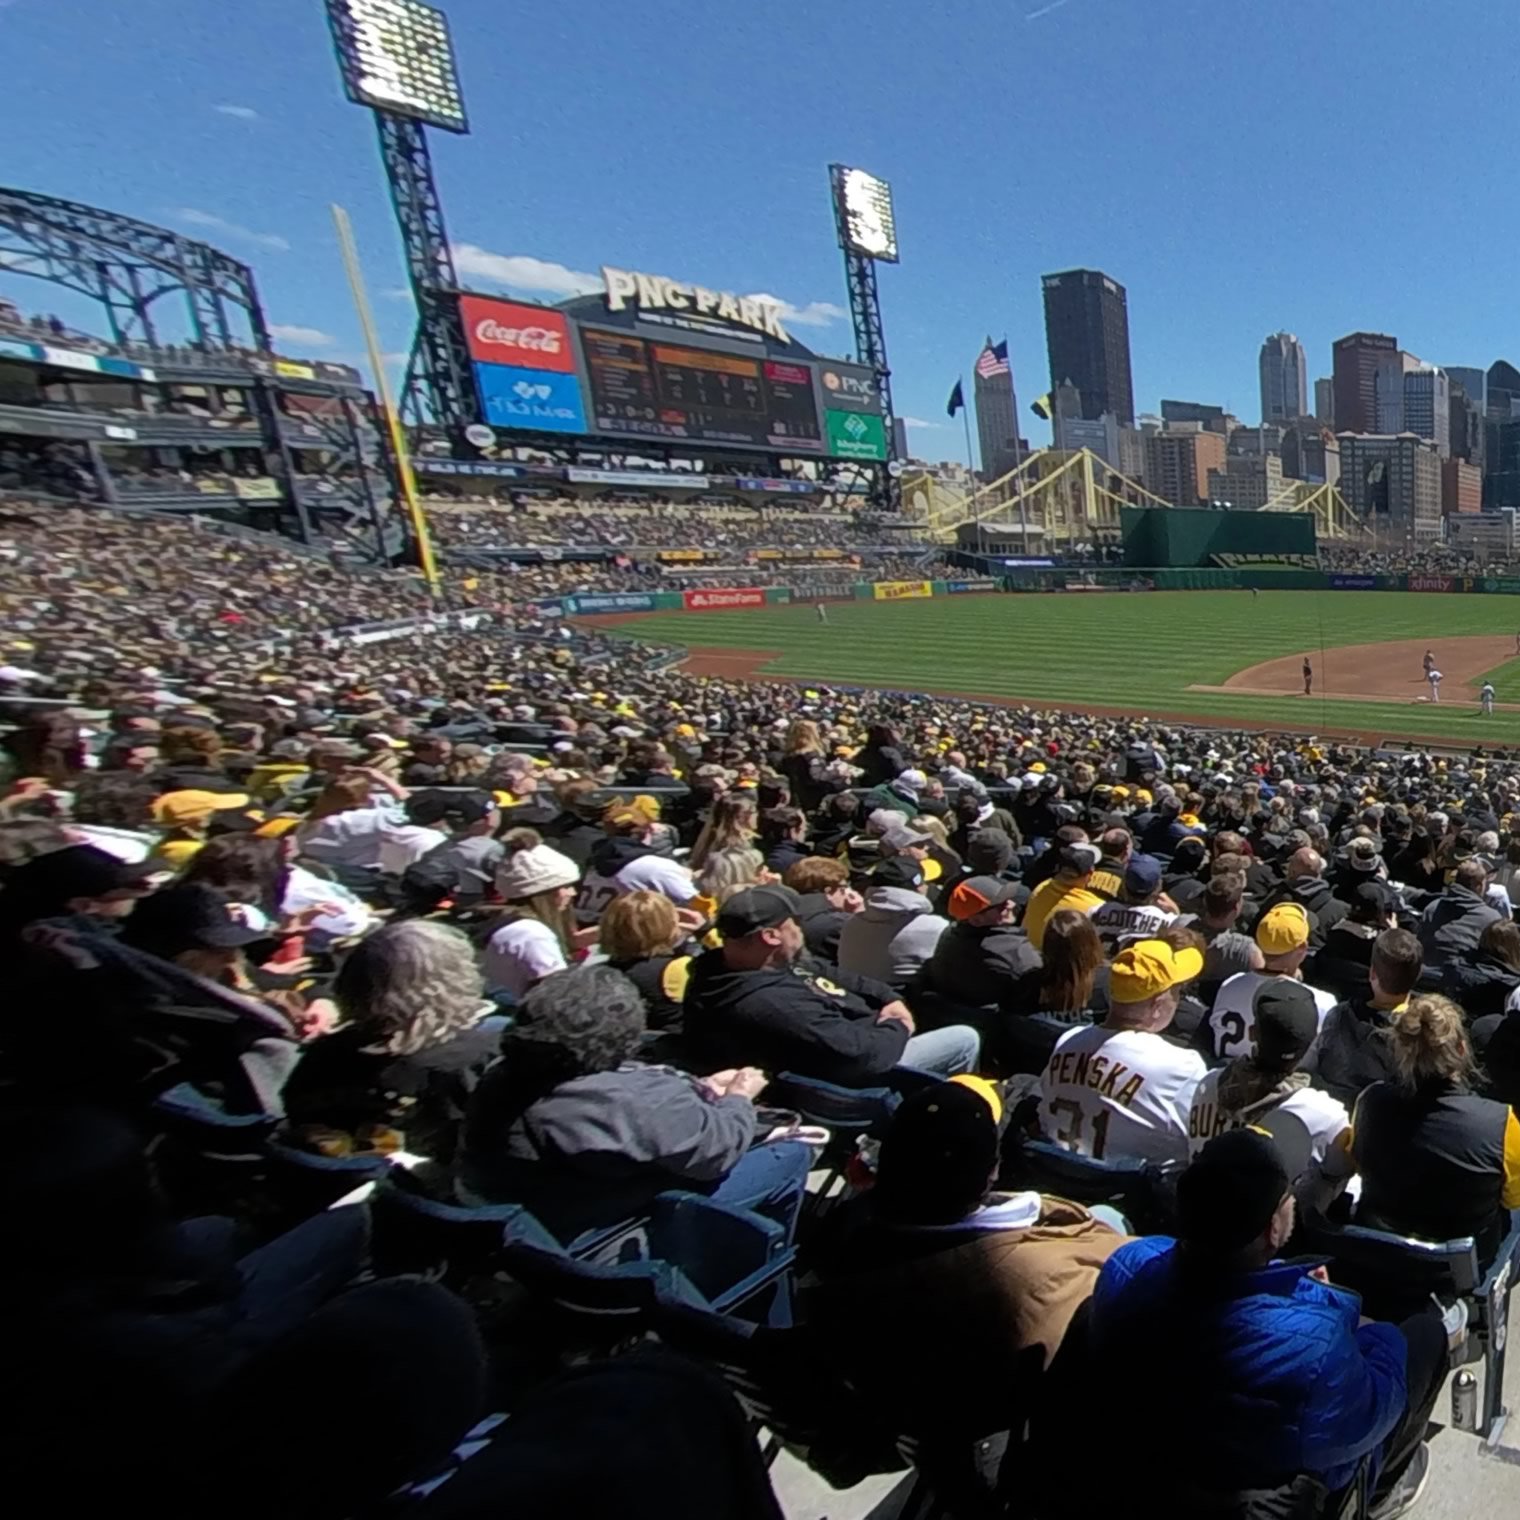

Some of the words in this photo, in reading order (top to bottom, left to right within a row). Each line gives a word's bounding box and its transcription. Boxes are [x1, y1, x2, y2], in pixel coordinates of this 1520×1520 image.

[602, 265, 690, 312] PNC
[693, 285, 791, 345] PARK
[476, 318, 563, 354] Coca-Cola
[841, 375, 877, 396] PNC
[1410, 578, 1450, 591] xfinity
[1463, 578, 1474, 592] P
[1050, 1052, 1145, 1107] PENSKA
[1049, 1097, 1112, 1159] 31
